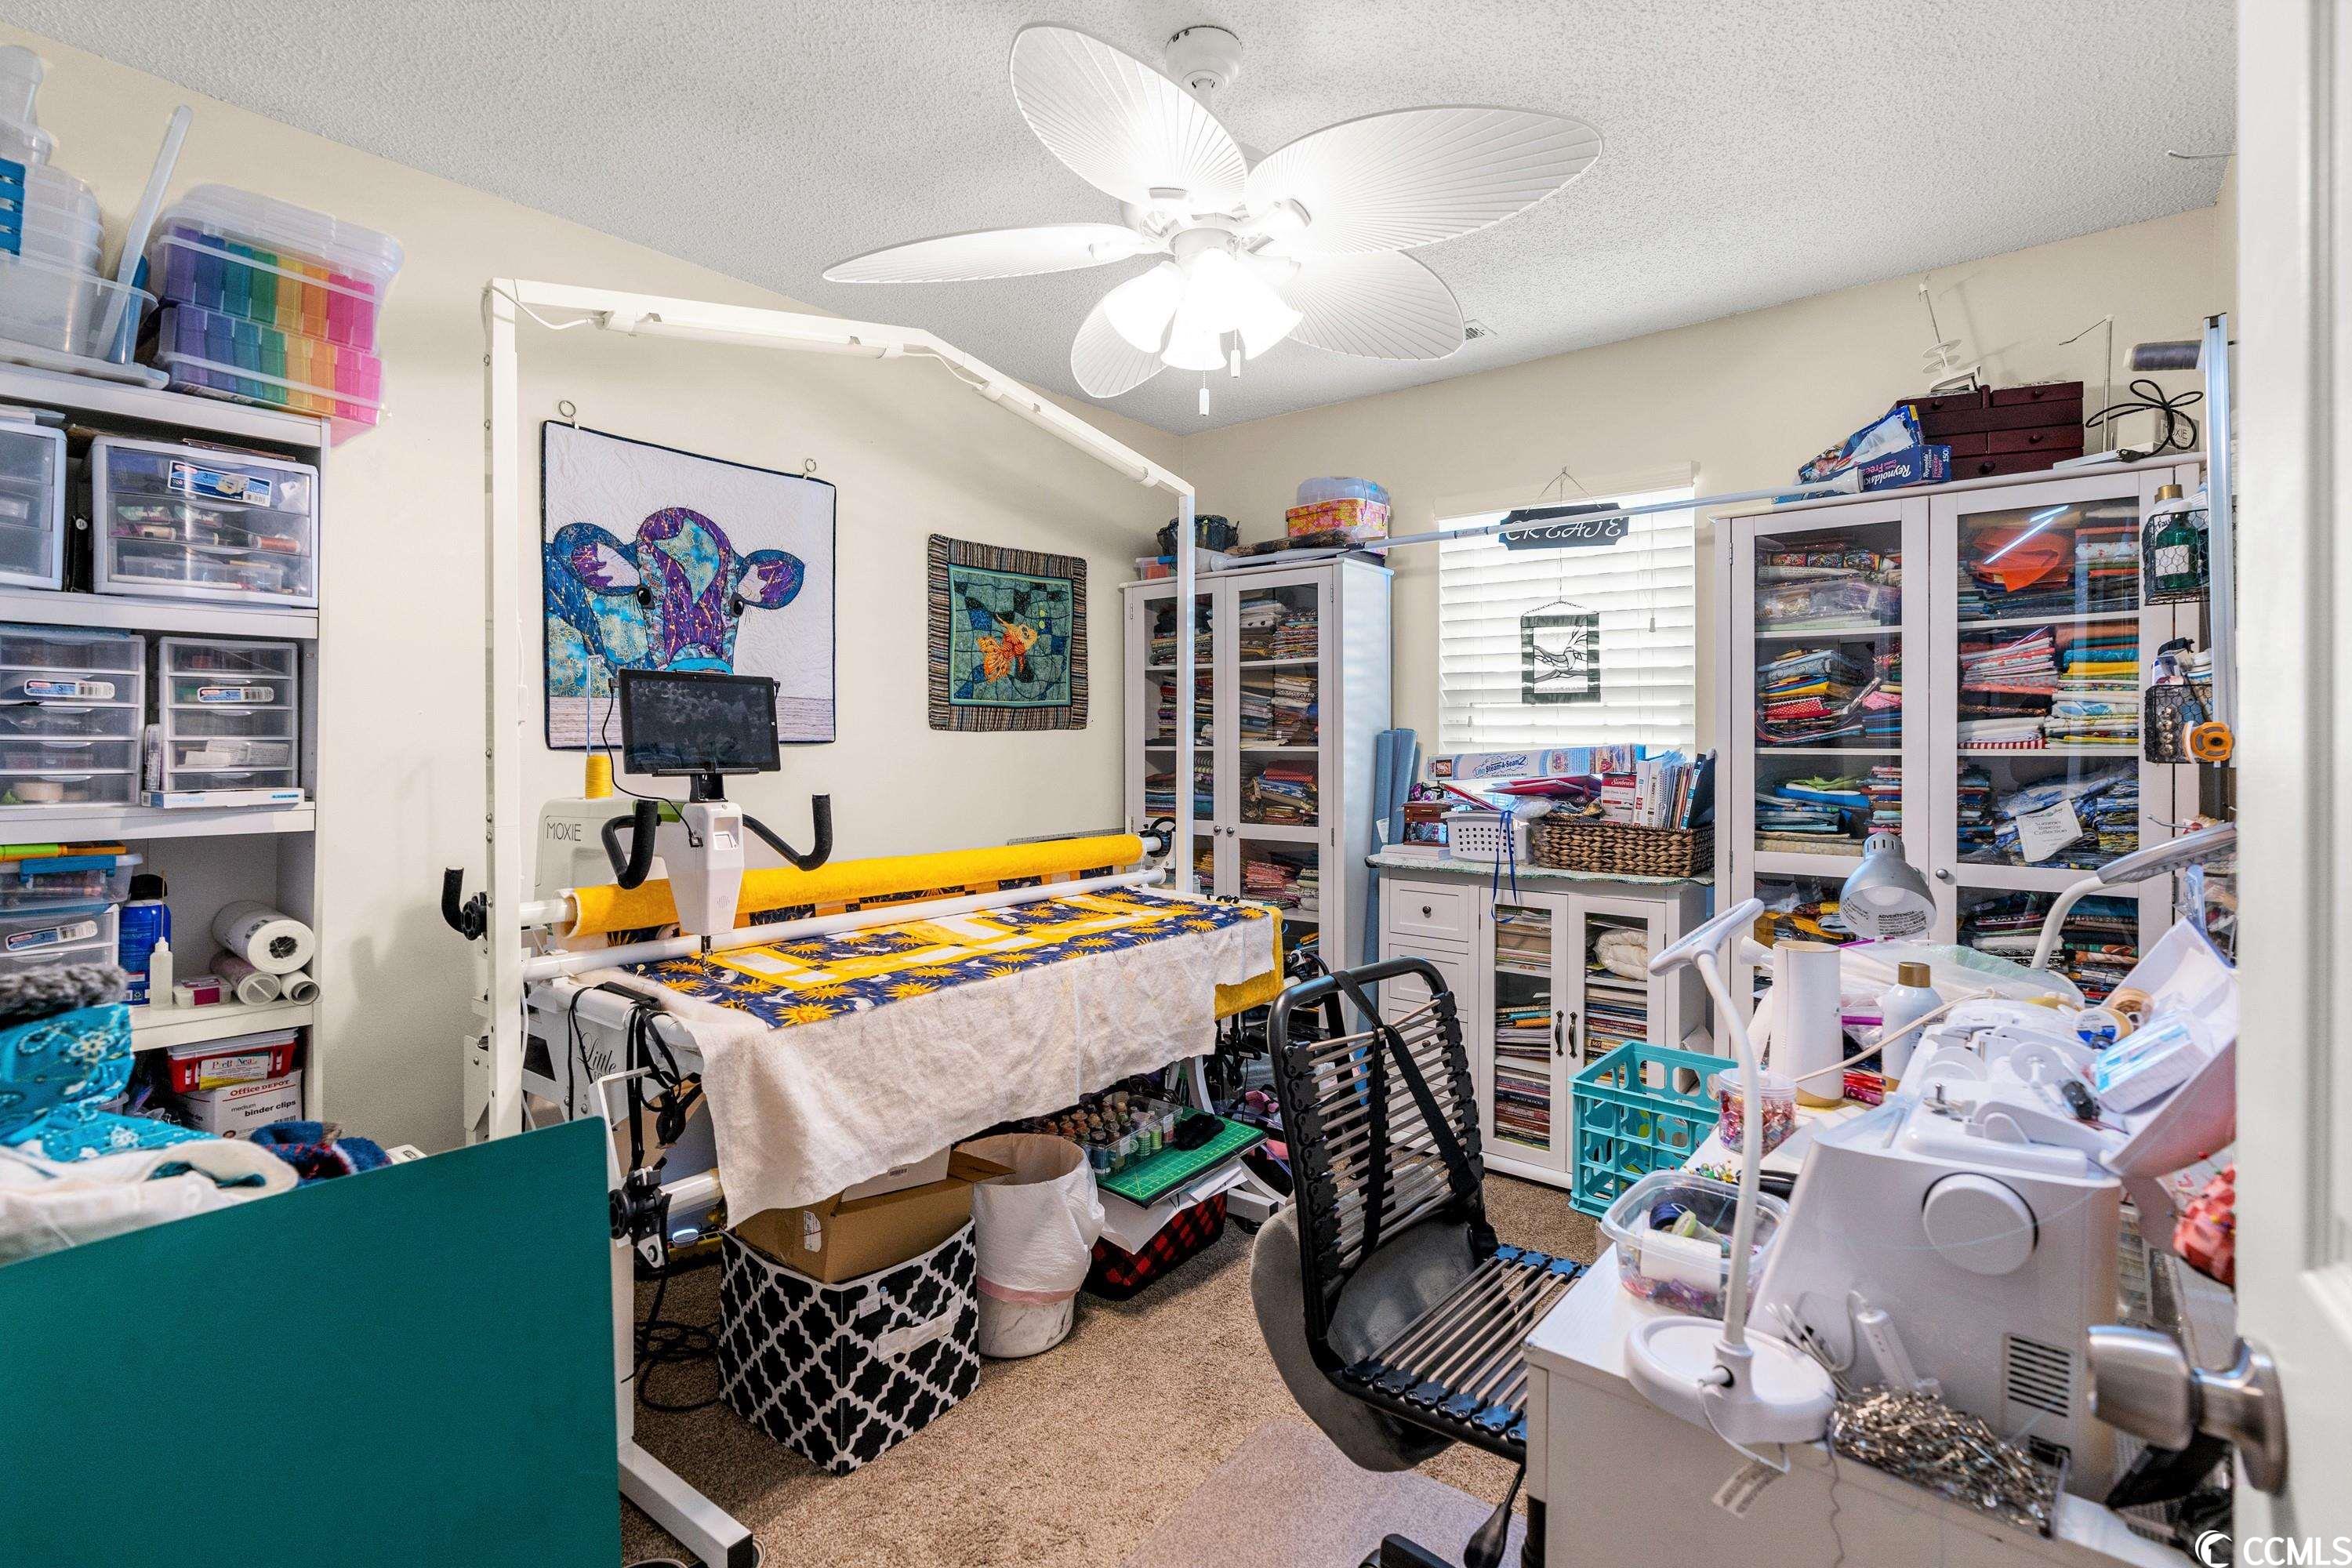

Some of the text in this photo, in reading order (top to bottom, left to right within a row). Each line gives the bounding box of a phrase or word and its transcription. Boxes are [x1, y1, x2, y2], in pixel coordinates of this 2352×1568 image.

[1871, 464, 1911, 485] Reynolds
[546, 822, 582, 841] MOXIE
[577, 1032, 615, 1075] Little
[230, 1079, 290, 1097] Office DEPOT
[231, 1103, 256, 1112] medium
[245, 1100, 296, 1117] binder clips
